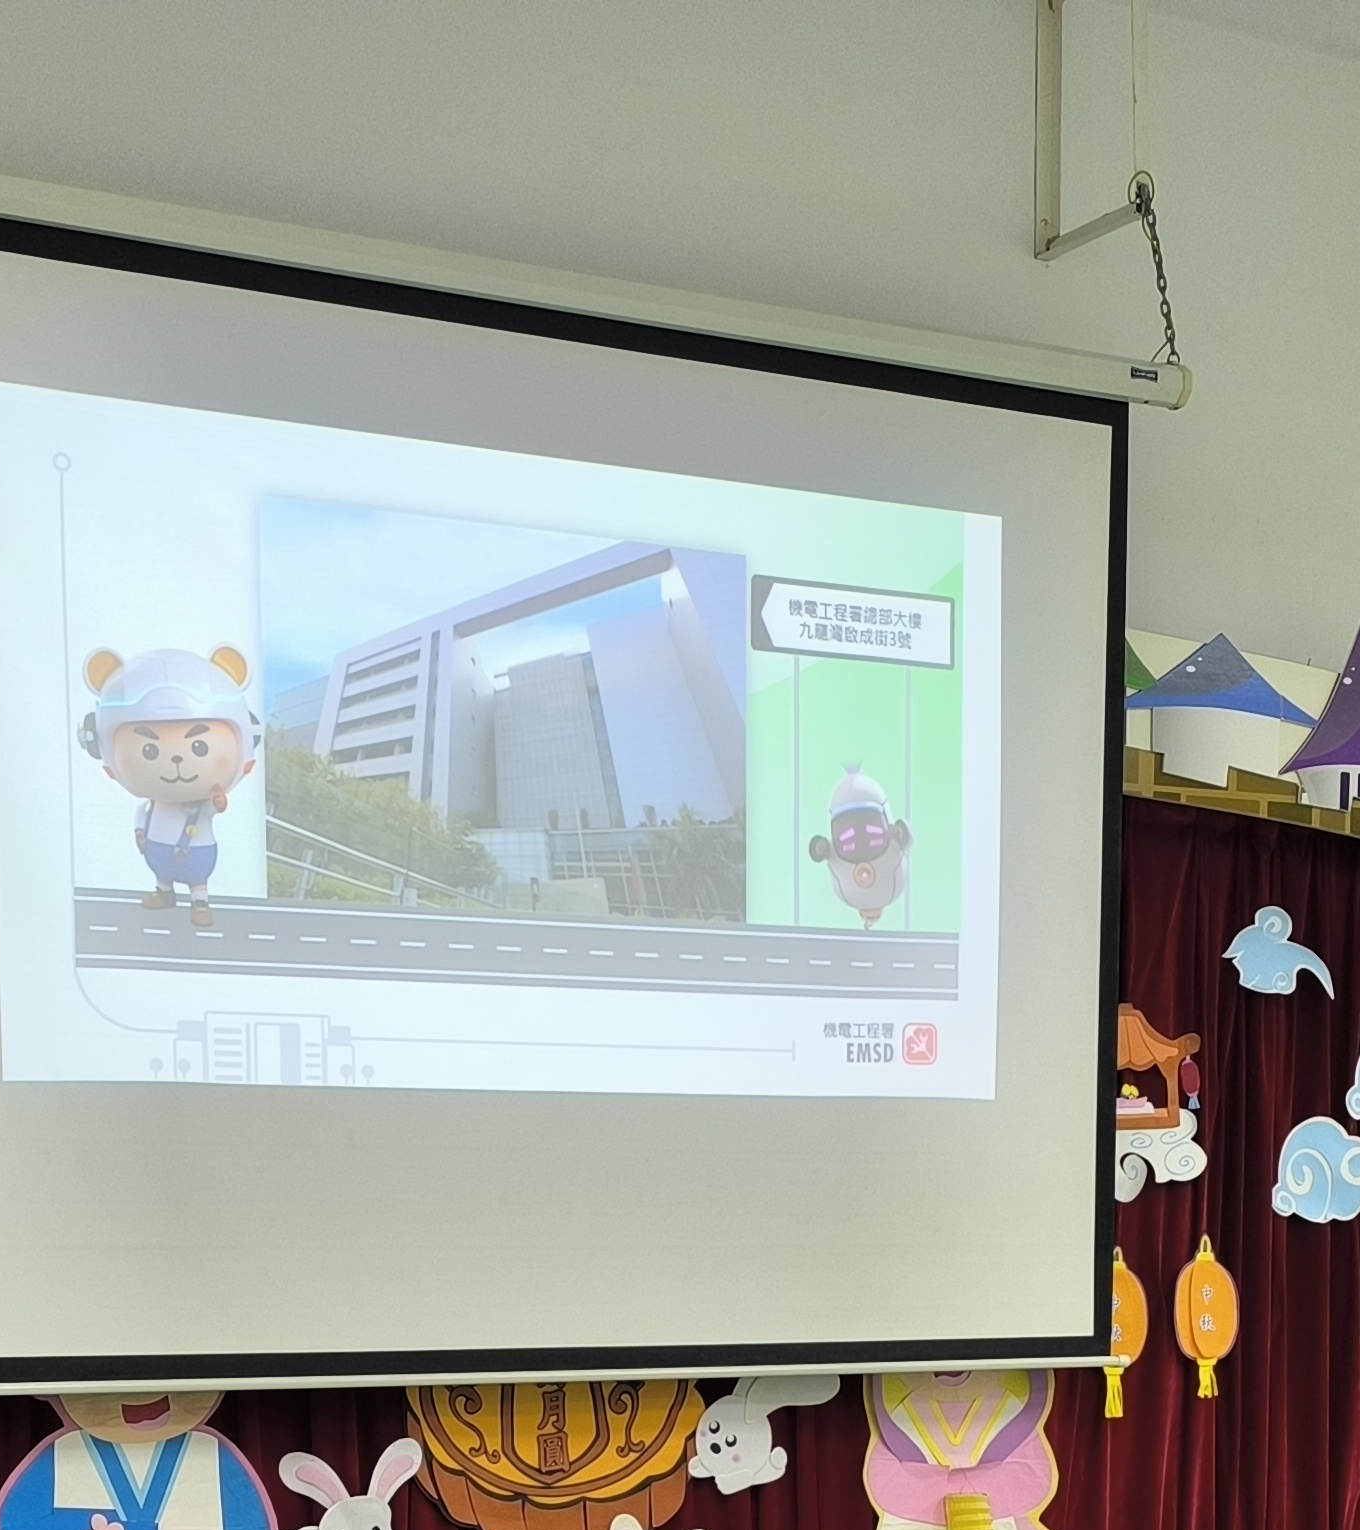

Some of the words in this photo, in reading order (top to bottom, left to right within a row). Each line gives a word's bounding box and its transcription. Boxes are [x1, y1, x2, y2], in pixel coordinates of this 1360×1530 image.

[788, 598, 922, 630] 機電工程署總部大樓
[823, 1022, 895, 1039] 機電工程署
[846, 1042, 894, 1063] EMSD
[1201, 1286, 1216, 1331] 中秋
